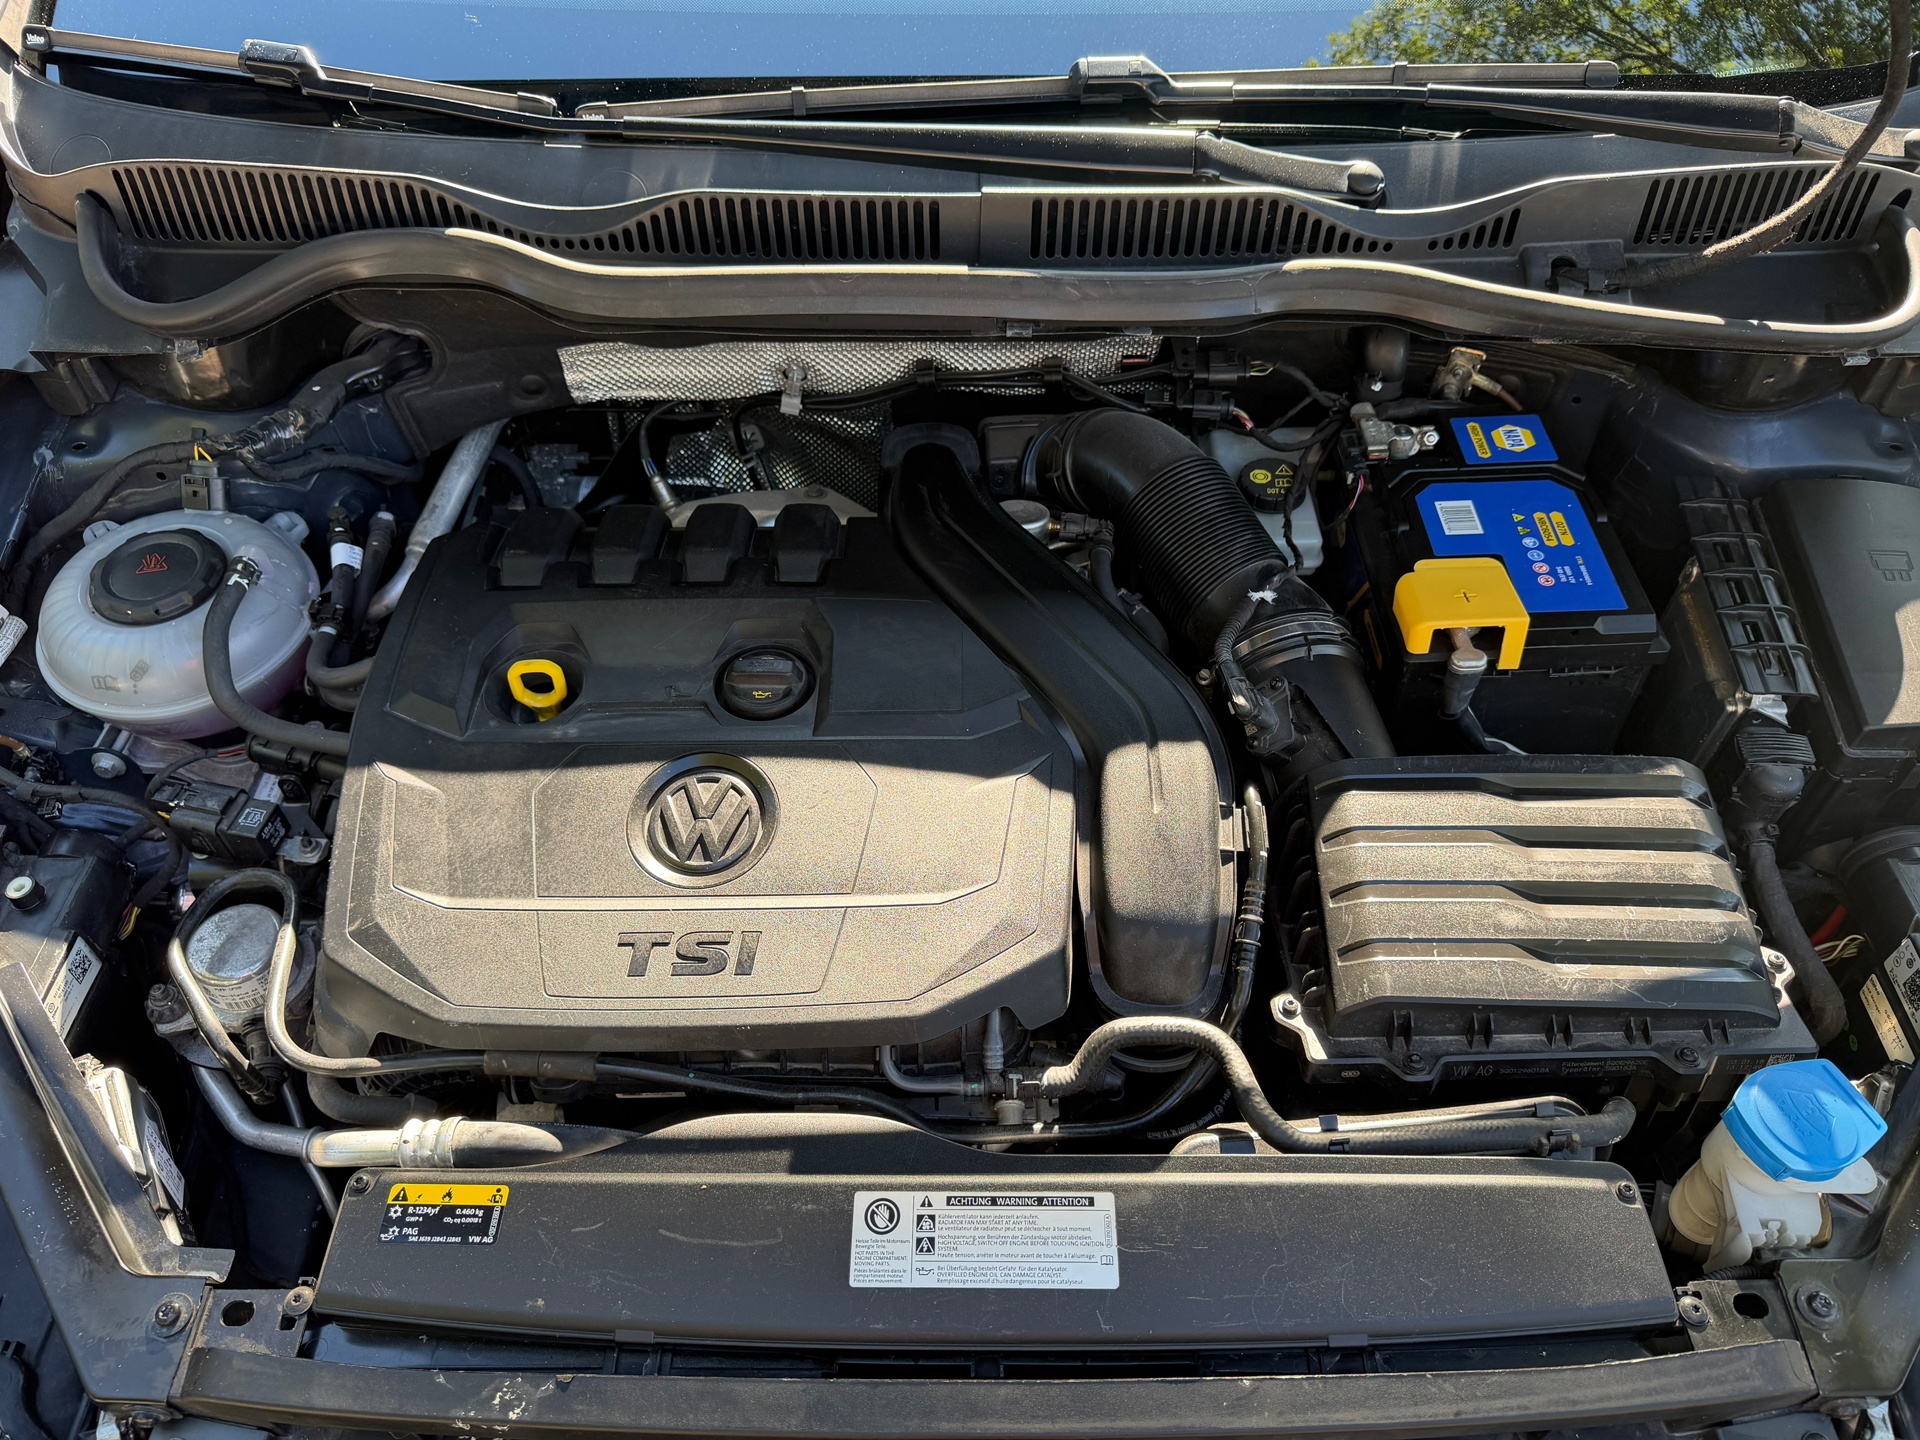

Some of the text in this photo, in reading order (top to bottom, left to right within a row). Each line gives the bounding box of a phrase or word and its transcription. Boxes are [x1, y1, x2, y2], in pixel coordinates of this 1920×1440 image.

[26, 33, 45, 45] Valeo
[1469, 425, 1489, 456] HIGH POWER
[1501, 429, 1525, 448] NAPA
[617, 931, 763, 978] TSI
[1453, 1065, 1470, 1076] VW
[1475, 1065, 1493, 1076] AG
[949, 1197, 1089, 1206] ACHTUNG WARNING ATTENTION
[408, 1206, 440, 1216] R-1234yf
[475, 1208, 484, 1217] kg
[402, 1227, 419, 1235] PAG
[947, 1265, 977, 1273] Überfüllung
